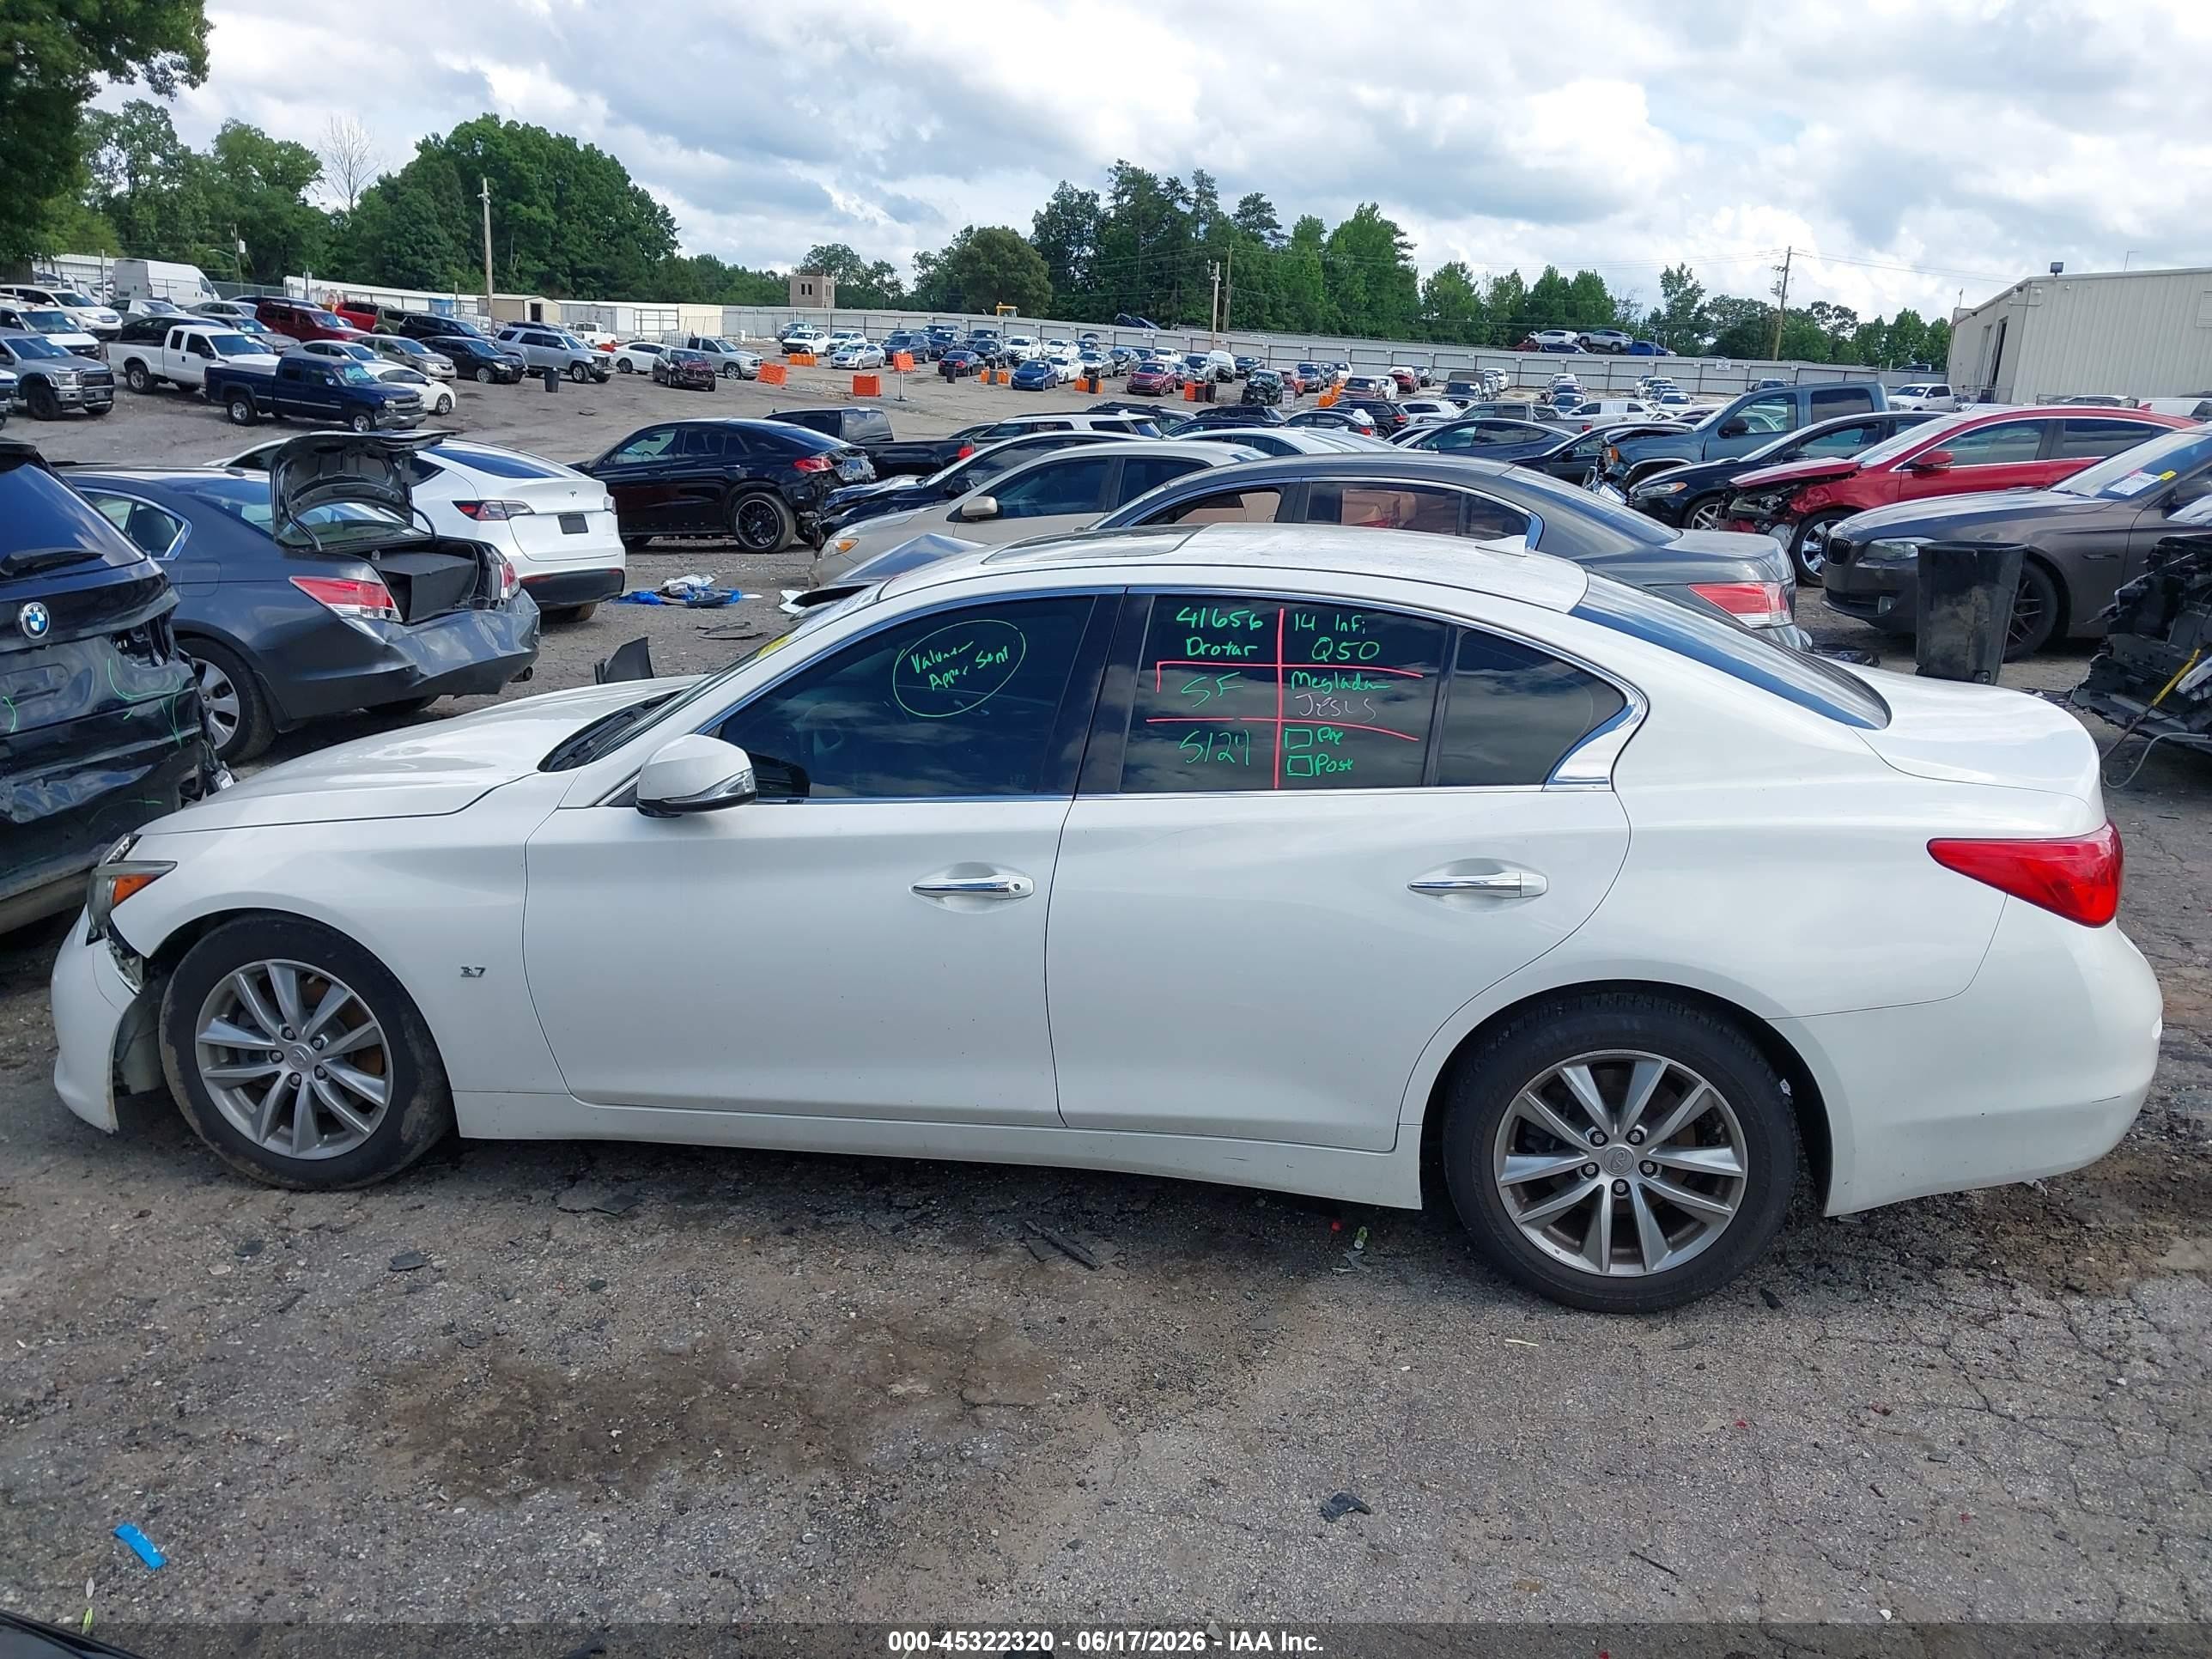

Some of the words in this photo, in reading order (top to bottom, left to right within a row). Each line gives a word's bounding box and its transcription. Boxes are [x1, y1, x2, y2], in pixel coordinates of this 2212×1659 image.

[1176, 606, 1264, 630] 41656
[1294, 612, 1316, 632] 14
[1311, 636, 1381, 663] Q50
[1315, 753, 1353, 776] Post
